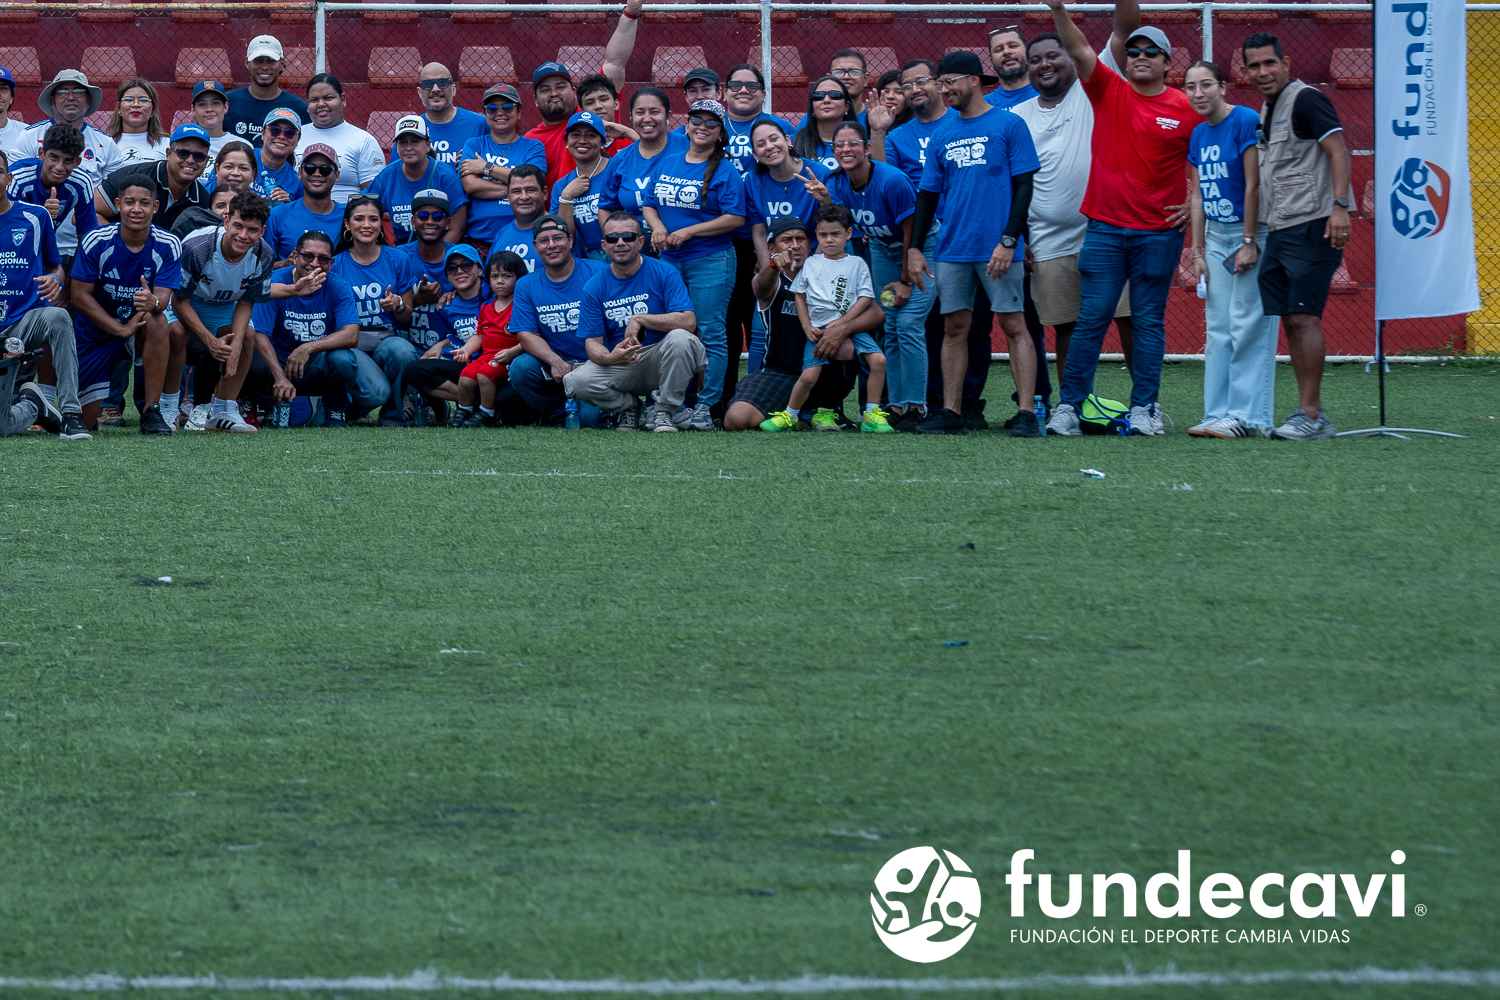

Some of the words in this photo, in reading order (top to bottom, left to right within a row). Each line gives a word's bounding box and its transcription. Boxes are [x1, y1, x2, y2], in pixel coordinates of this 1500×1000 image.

[1422, 60, 1438, 136] FUNDACIÓN
[1155, 116, 1181, 126] CREW
[430, 140, 450, 152] VO
[944, 136, 989, 150] VOLUNTARIO
[485, 152, 509, 167] VO
[945, 146, 971, 161] GEN
[1201, 144, 1220, 163] VO
[956, 158, 972, 168] TE
[1198, 161, 1229, 180] LUN
[1200, 181, 1221, 199] TA
[657, 193, 676, 207] TE
[675, 200, 700, 210] Media
[767, 201, 793, 215] VO
[850, 208, 876, 226] VO
[1218, 214, 1240, 223] Media
[213, 289, 234, 300] 10
[352, 282, 382, 300] VO
[834, 276, 848, 309] UMMER
[356, 298, 384, 316] LU
[602, 293, 649, 308] VOLUNTARIO
[285, 310, 327, 320] VOLUNTARIO
[539, 311, 565, 325] GEN
[605, 305, 632, 320] GEN
[283, 319, 309, 334] GEN
[411, 312, 430, 329] TA
[550, 322, 567, 333] TE
[295, 331, 309, 342] TE
